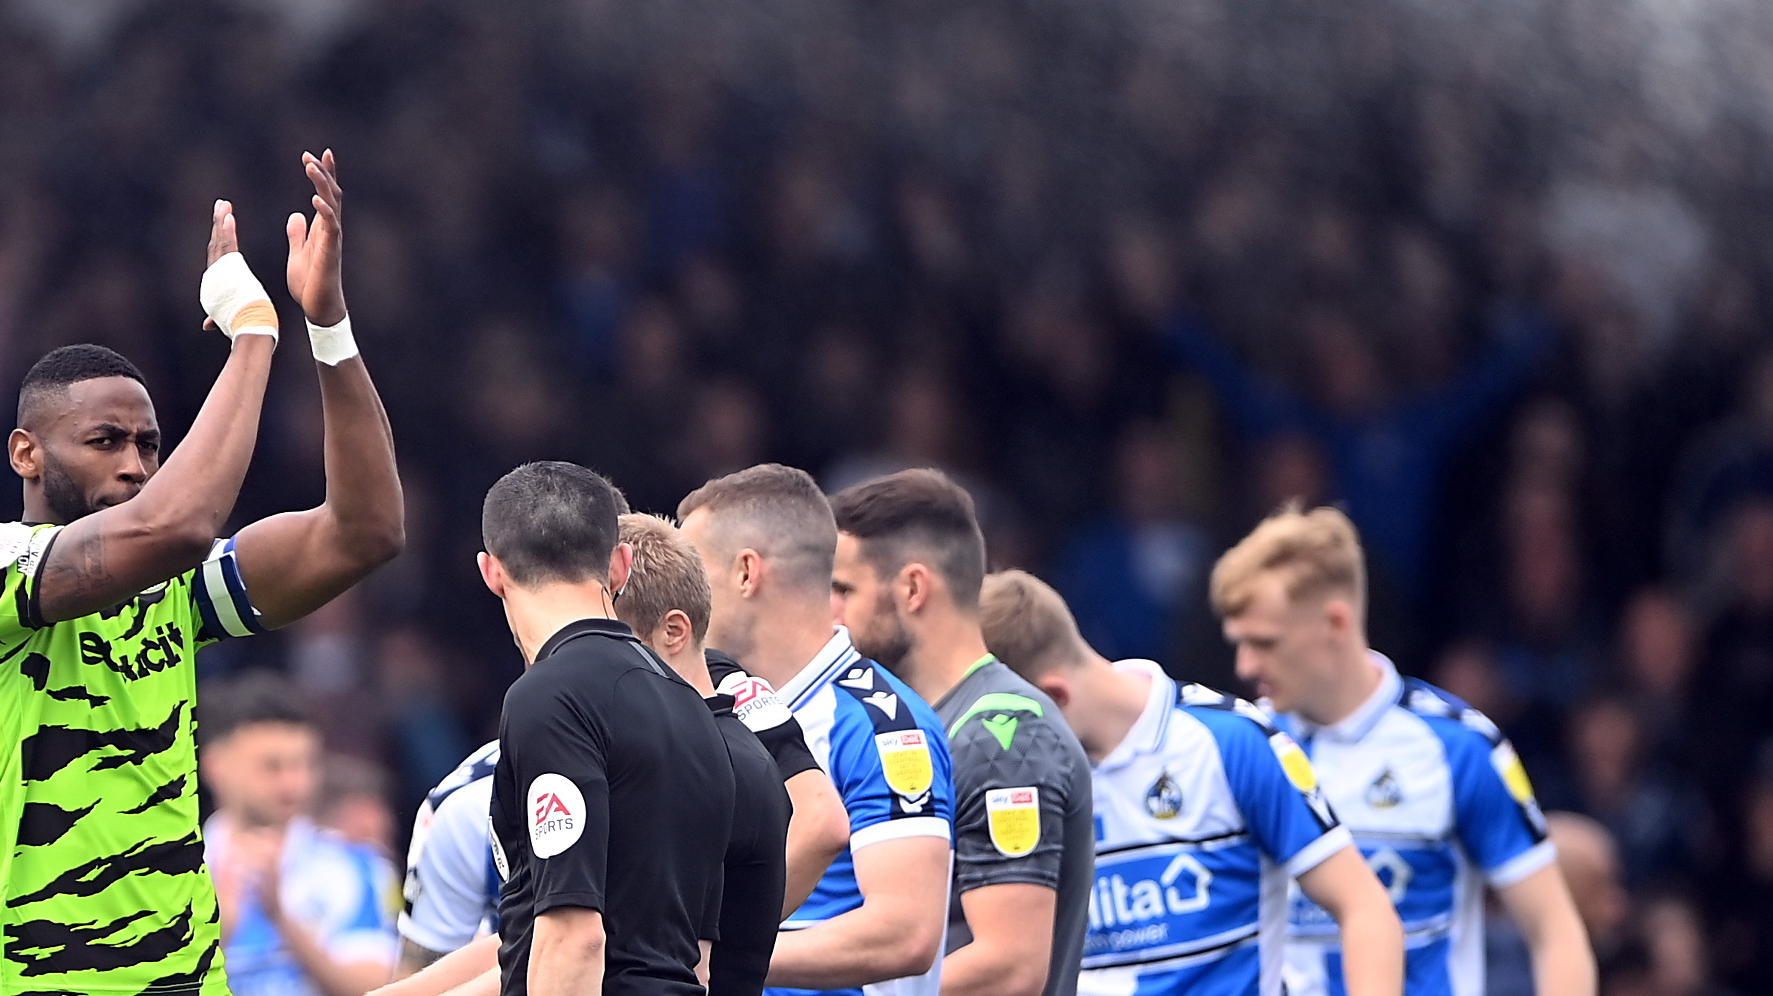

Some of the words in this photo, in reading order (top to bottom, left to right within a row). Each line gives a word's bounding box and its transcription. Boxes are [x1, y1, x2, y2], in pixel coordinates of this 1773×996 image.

[730, 680, 775, 709] EA
[737, 696, 783, 721] SPORTS
[536, 792, 571, 826] EA
[535, 818, 574, 840] SPORTS
